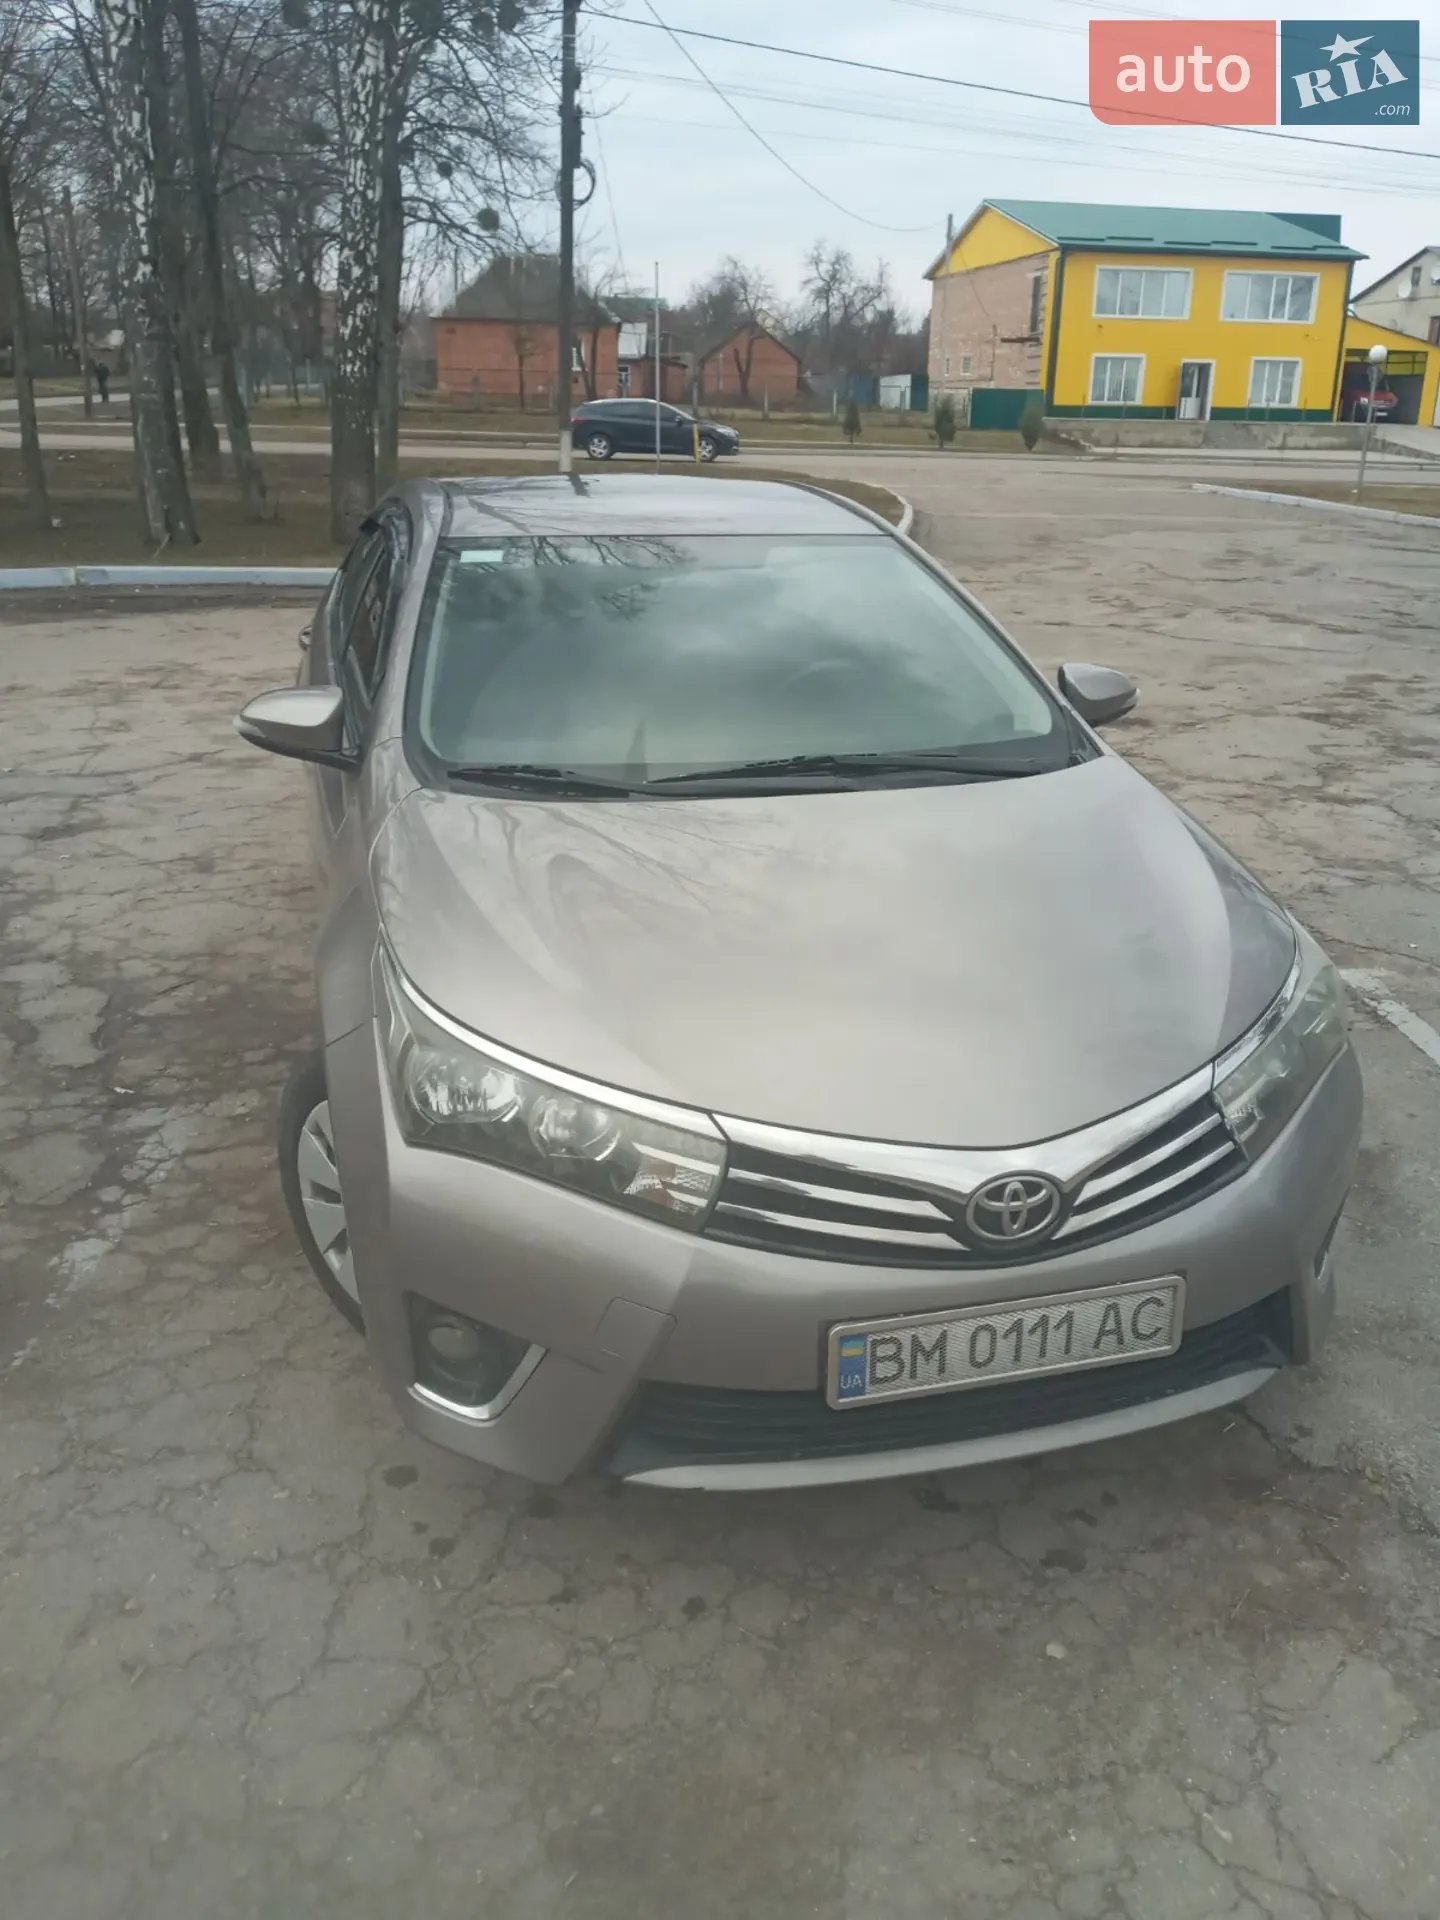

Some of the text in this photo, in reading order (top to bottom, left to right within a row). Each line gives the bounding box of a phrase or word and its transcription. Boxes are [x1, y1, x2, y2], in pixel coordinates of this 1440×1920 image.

[868, 1295, 1165, 1386] BM 0111 AC
[839, 1372, 863, 1390] UA
